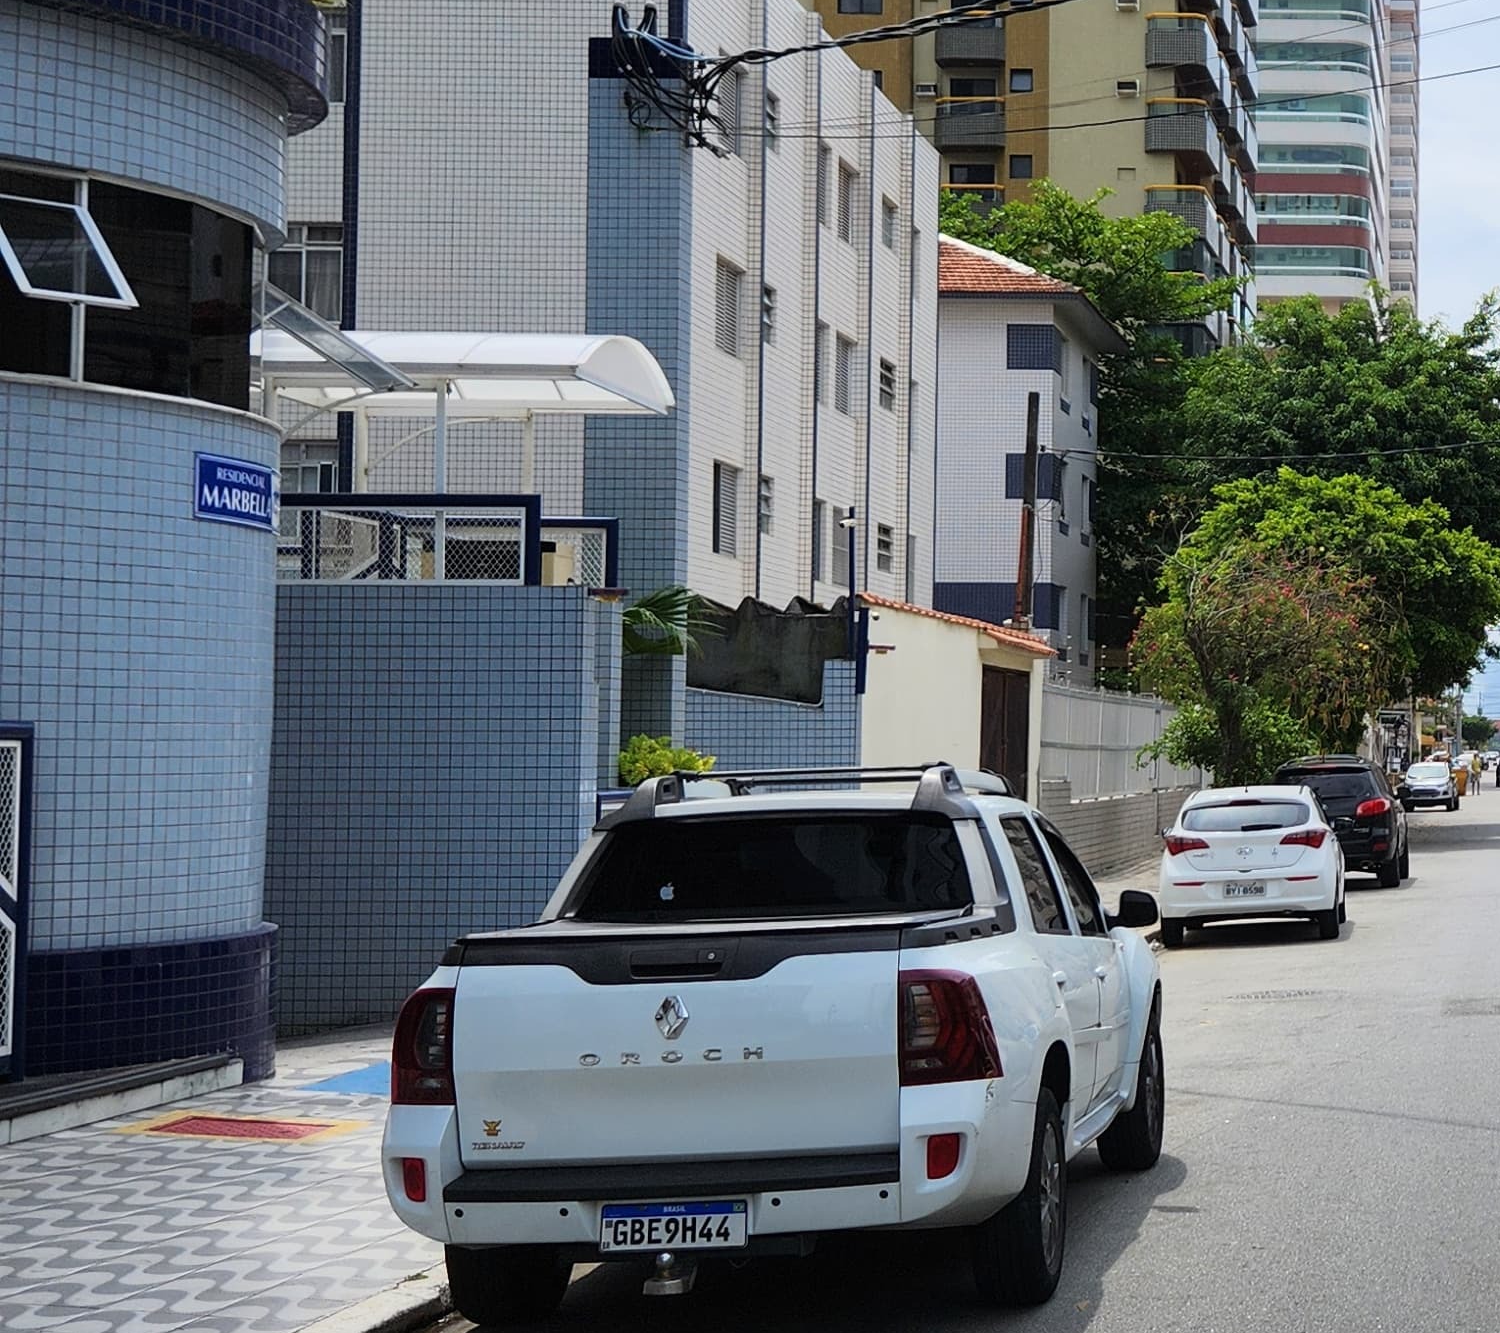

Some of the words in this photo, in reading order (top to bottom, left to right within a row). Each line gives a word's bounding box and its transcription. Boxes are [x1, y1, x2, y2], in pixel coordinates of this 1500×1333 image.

[579, 1046, 763, 1066] OROCH
[663, 1204, 686, 1213] BRASIL
[613, 1216, 730, 1246] GBE9H44
